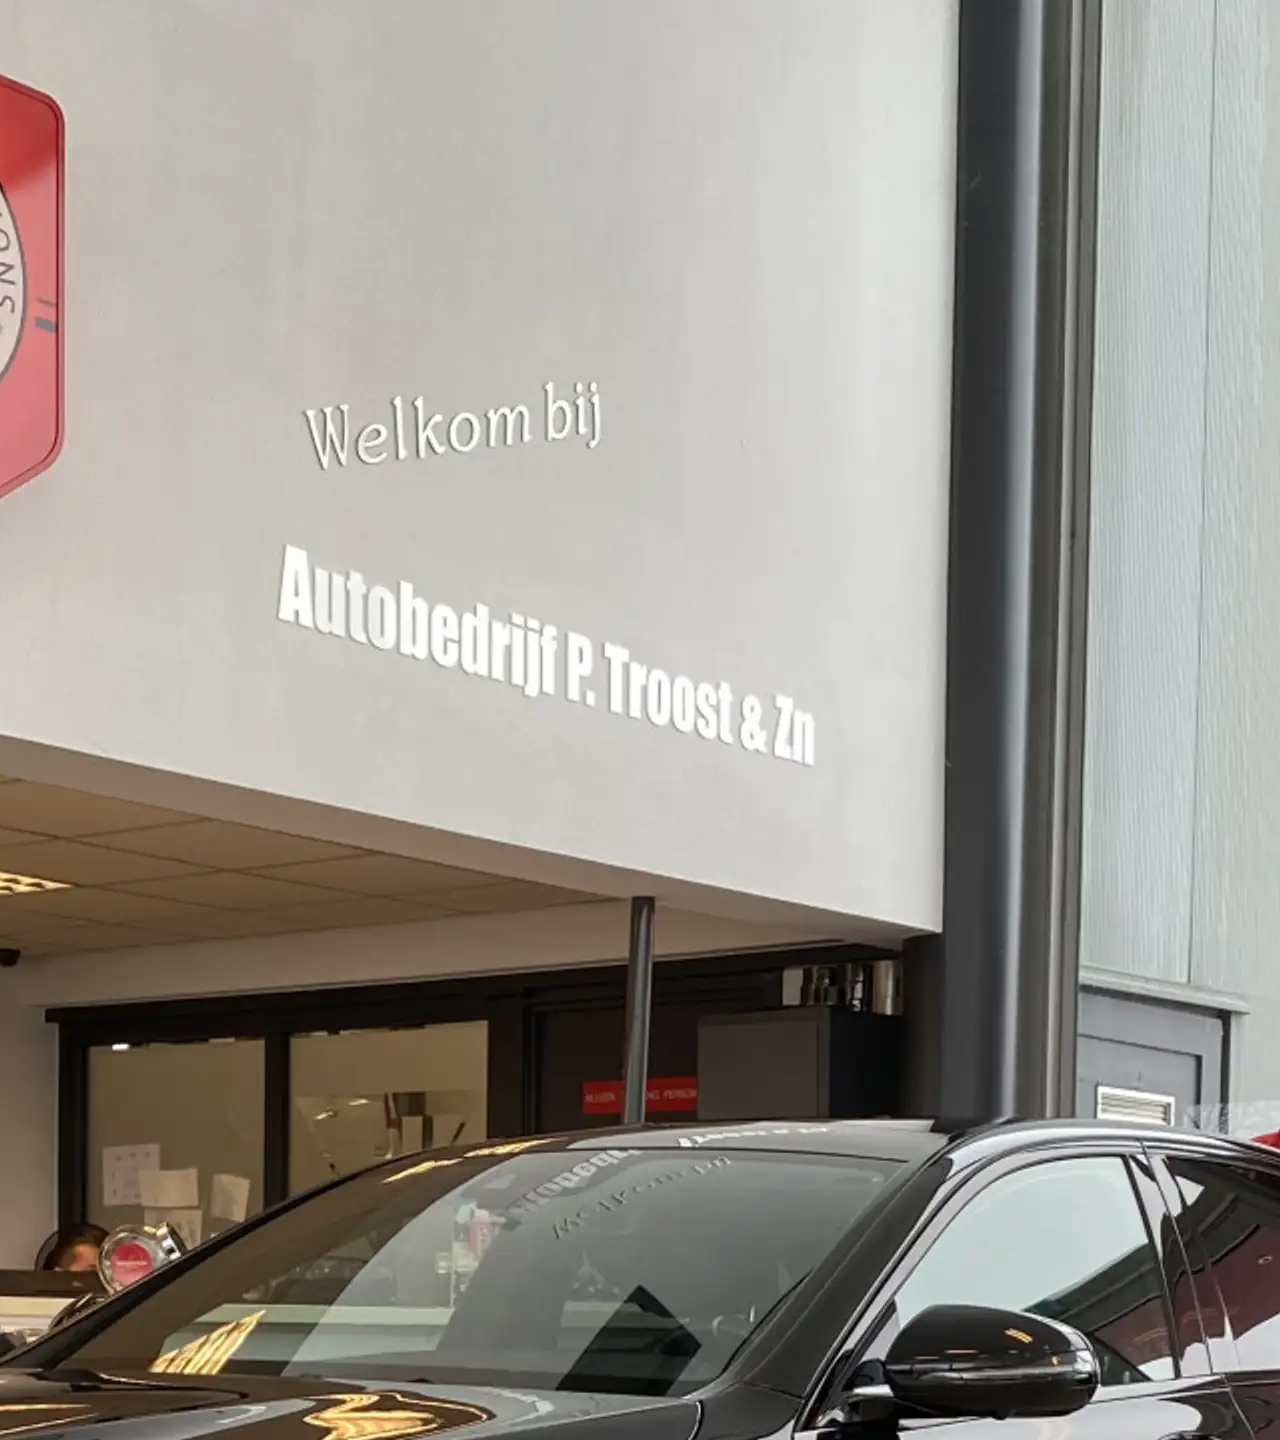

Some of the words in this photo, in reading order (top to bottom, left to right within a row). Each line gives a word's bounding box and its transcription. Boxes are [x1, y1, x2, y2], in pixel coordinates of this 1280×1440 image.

[302, 395, 532, 471] Welkom
[541, 382, 602, 448] bij
[277, 543, 558, 698] Autobedrijf
[566, 631, 596, 707] P.
[603, 641, 733, 744] Troost
[738, 694, 767, 753] &
[773, 692, 816, 766] Zn
